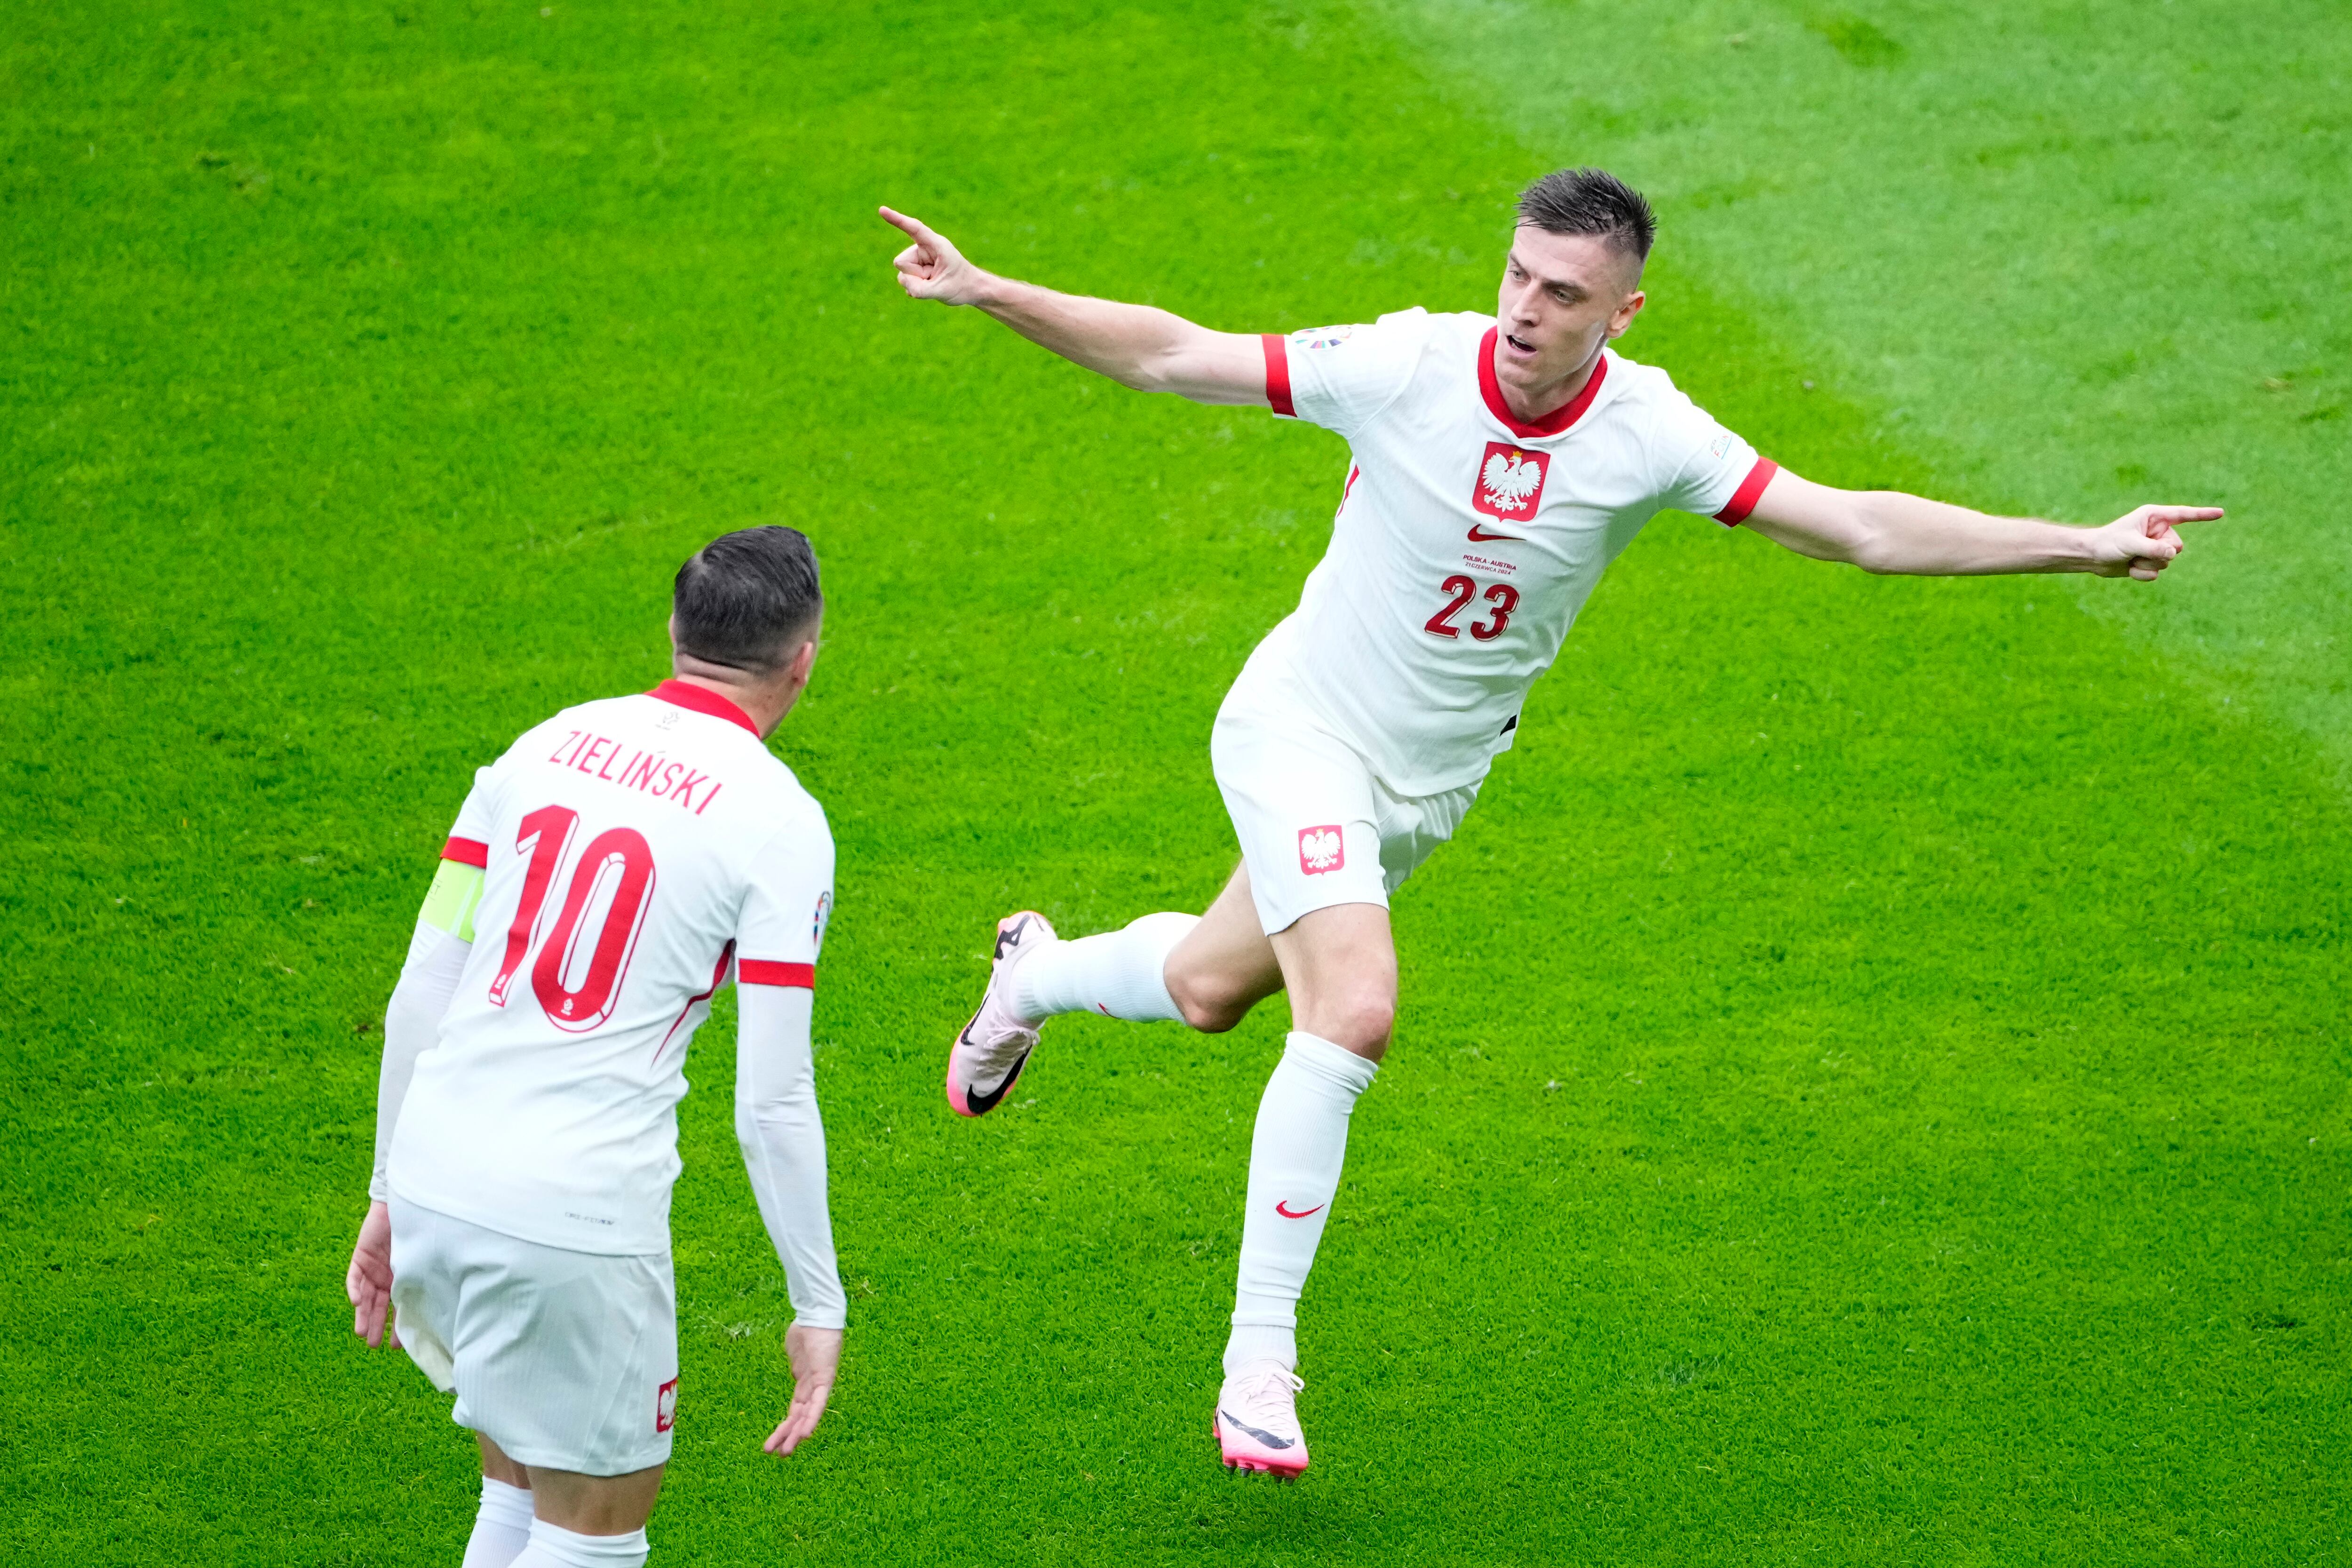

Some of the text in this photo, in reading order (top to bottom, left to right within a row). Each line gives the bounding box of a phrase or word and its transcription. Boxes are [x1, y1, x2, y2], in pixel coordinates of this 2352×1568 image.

[1463, 555, 1486, 564] POLSKA
[1490, 560, 1517, 570] AUSTRIA
[1424, 575, 1519, 642] 23
[548, 731, 723, 815] ZIELIŃSKI
[489, 804, 656, 1033] 10
